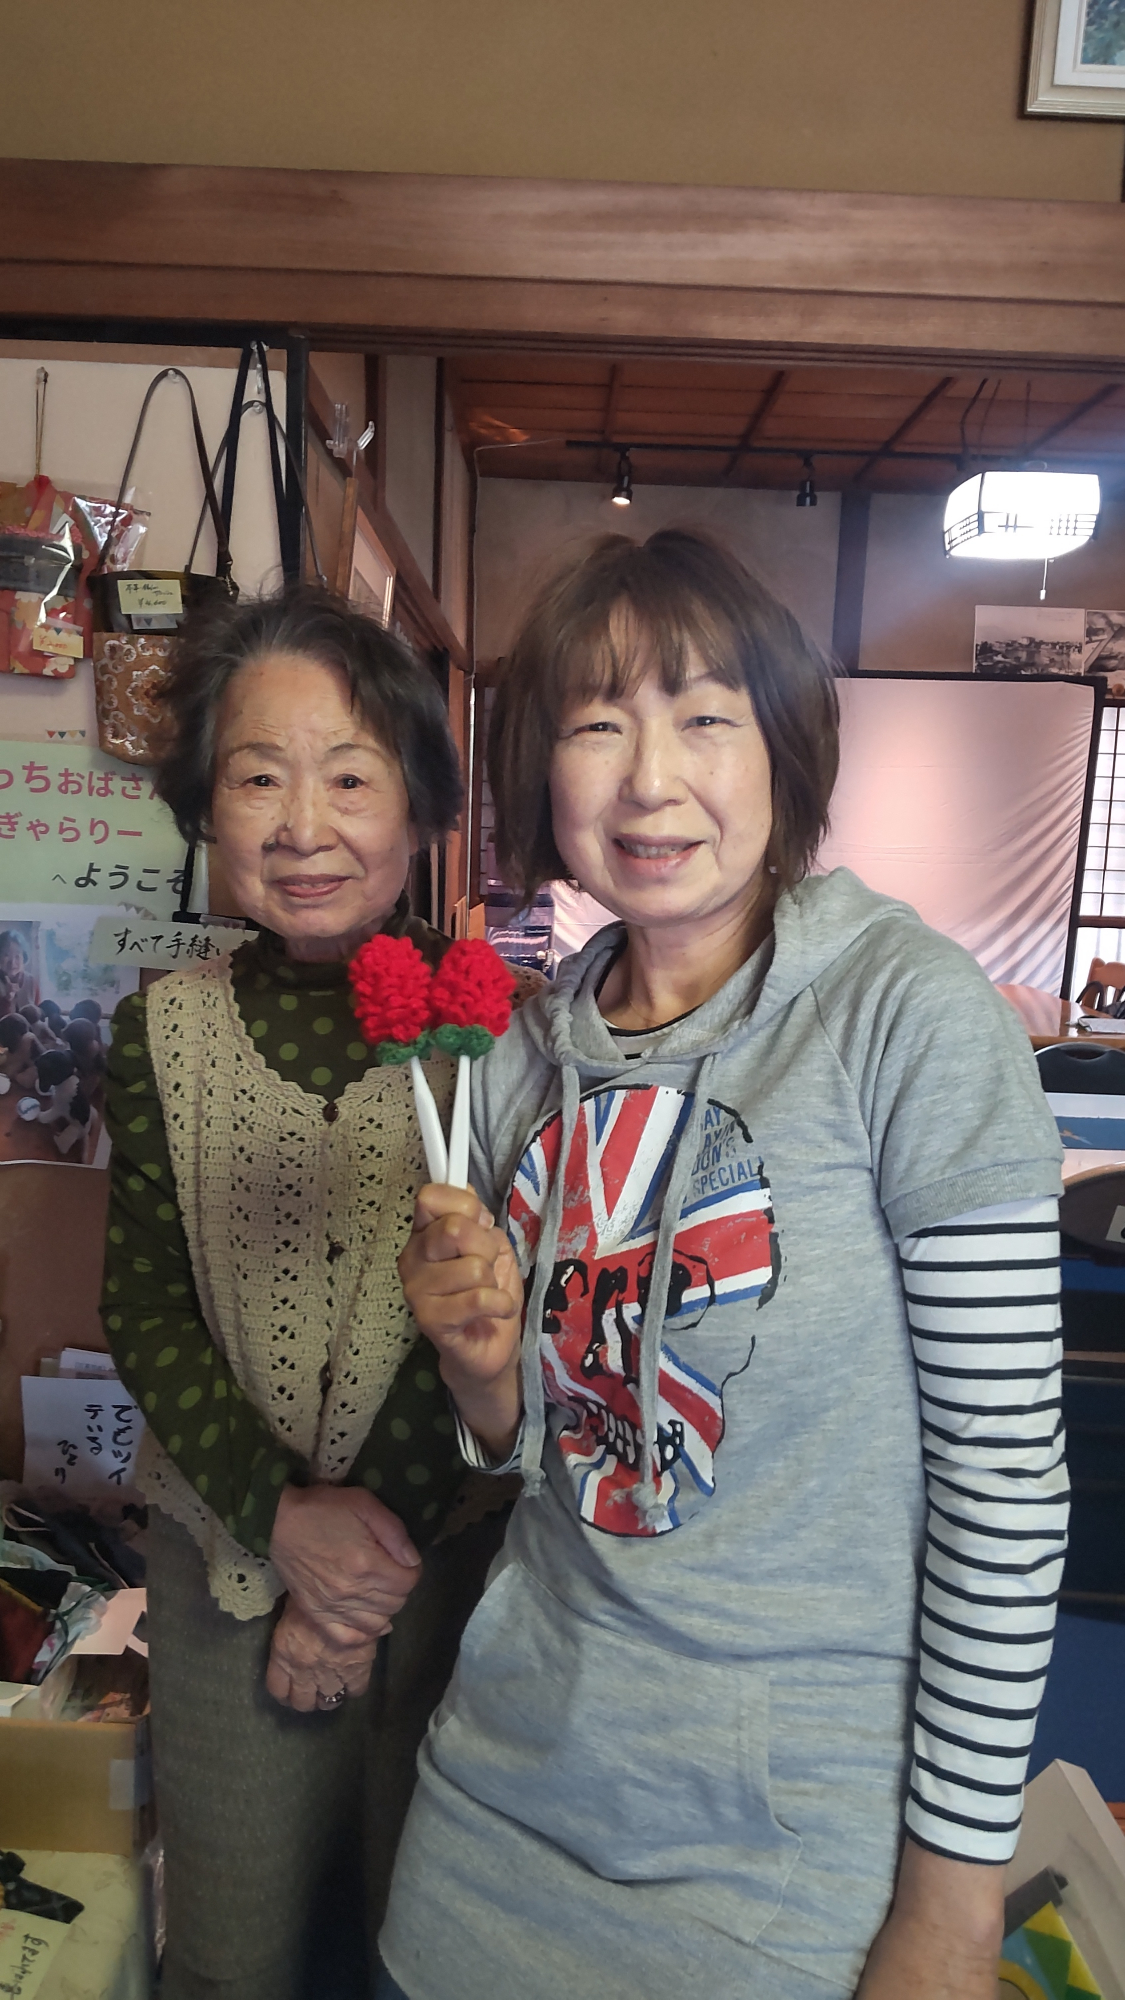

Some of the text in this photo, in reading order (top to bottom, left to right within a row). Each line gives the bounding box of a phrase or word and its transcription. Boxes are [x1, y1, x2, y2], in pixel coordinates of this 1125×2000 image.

[0, 811, 143, 845] ぎゃらりー
[700, 1106, 722, 1131] AY
